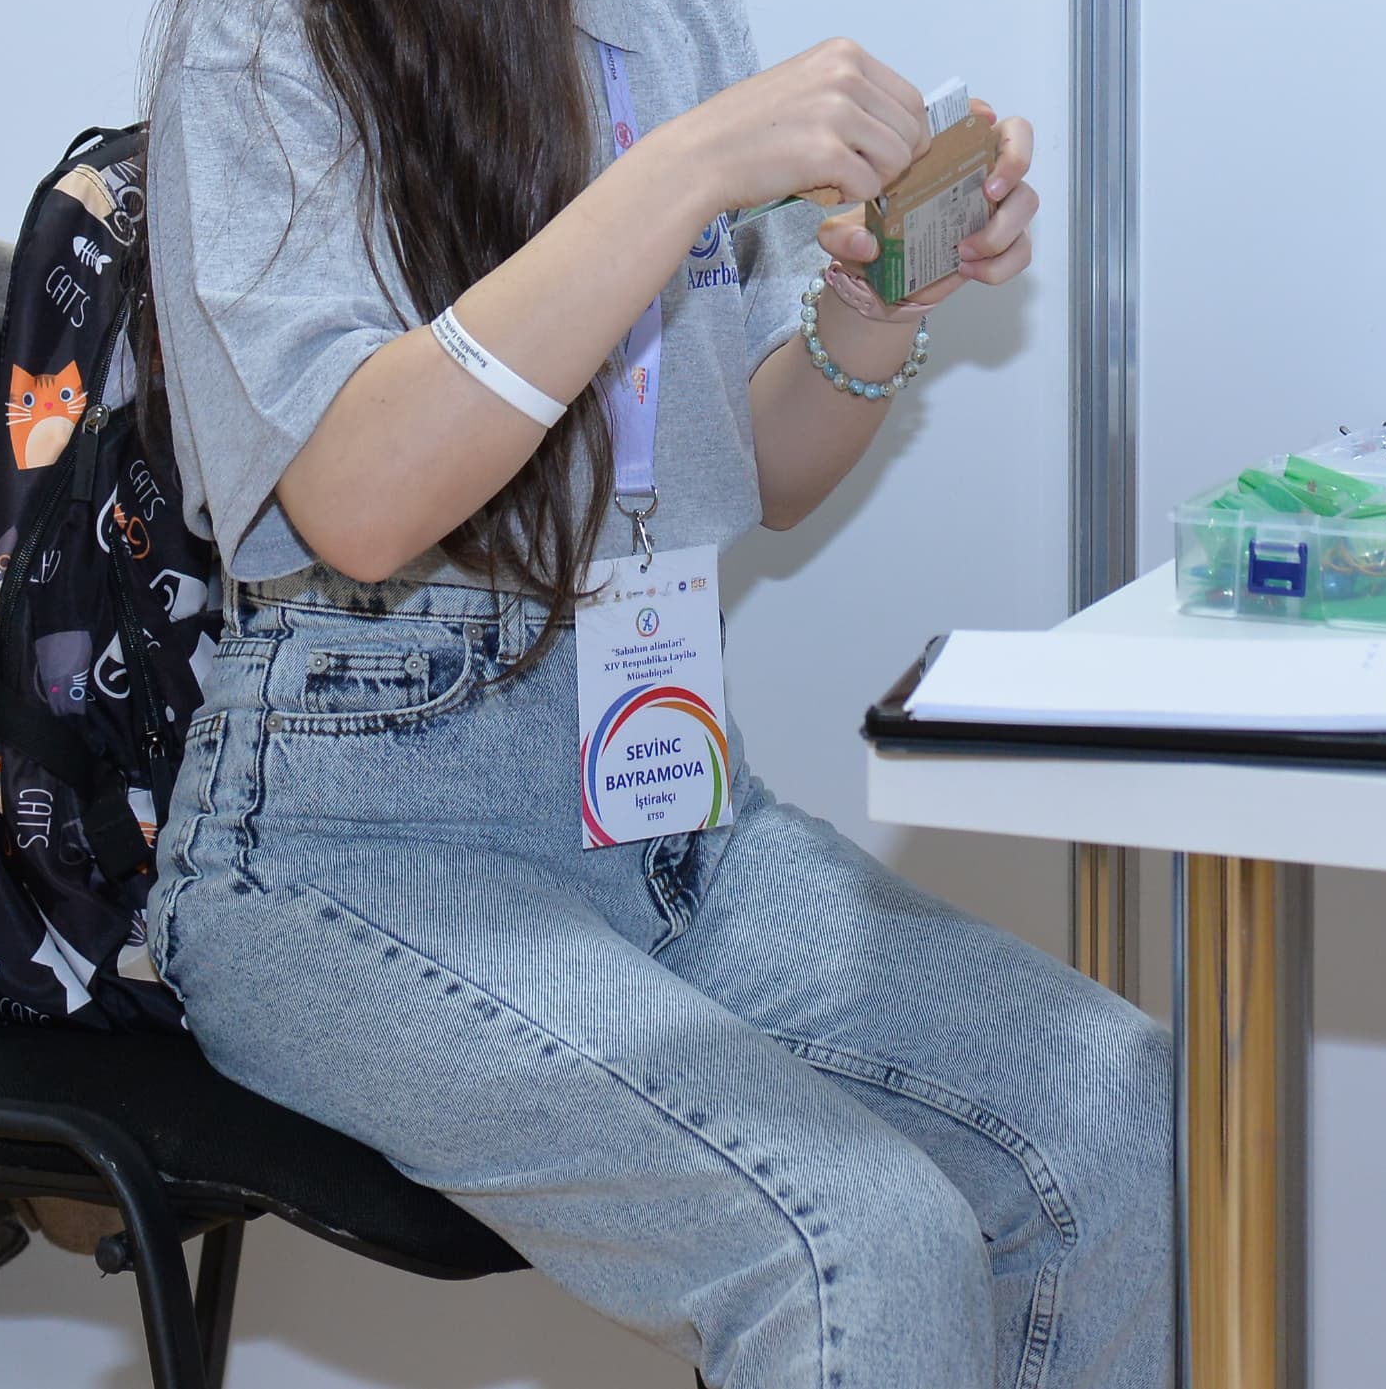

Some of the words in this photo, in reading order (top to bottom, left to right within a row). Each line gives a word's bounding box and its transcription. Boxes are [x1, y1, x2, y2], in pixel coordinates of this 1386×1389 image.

[46, 265, 91, 328] CATS
[130, 460, 166, 522] CATS
[606, 760, 704, 792] BAYRAMOVA
[626, 737, 681, 762] SEVİNC
[16, 788, 53, 849] CATS
